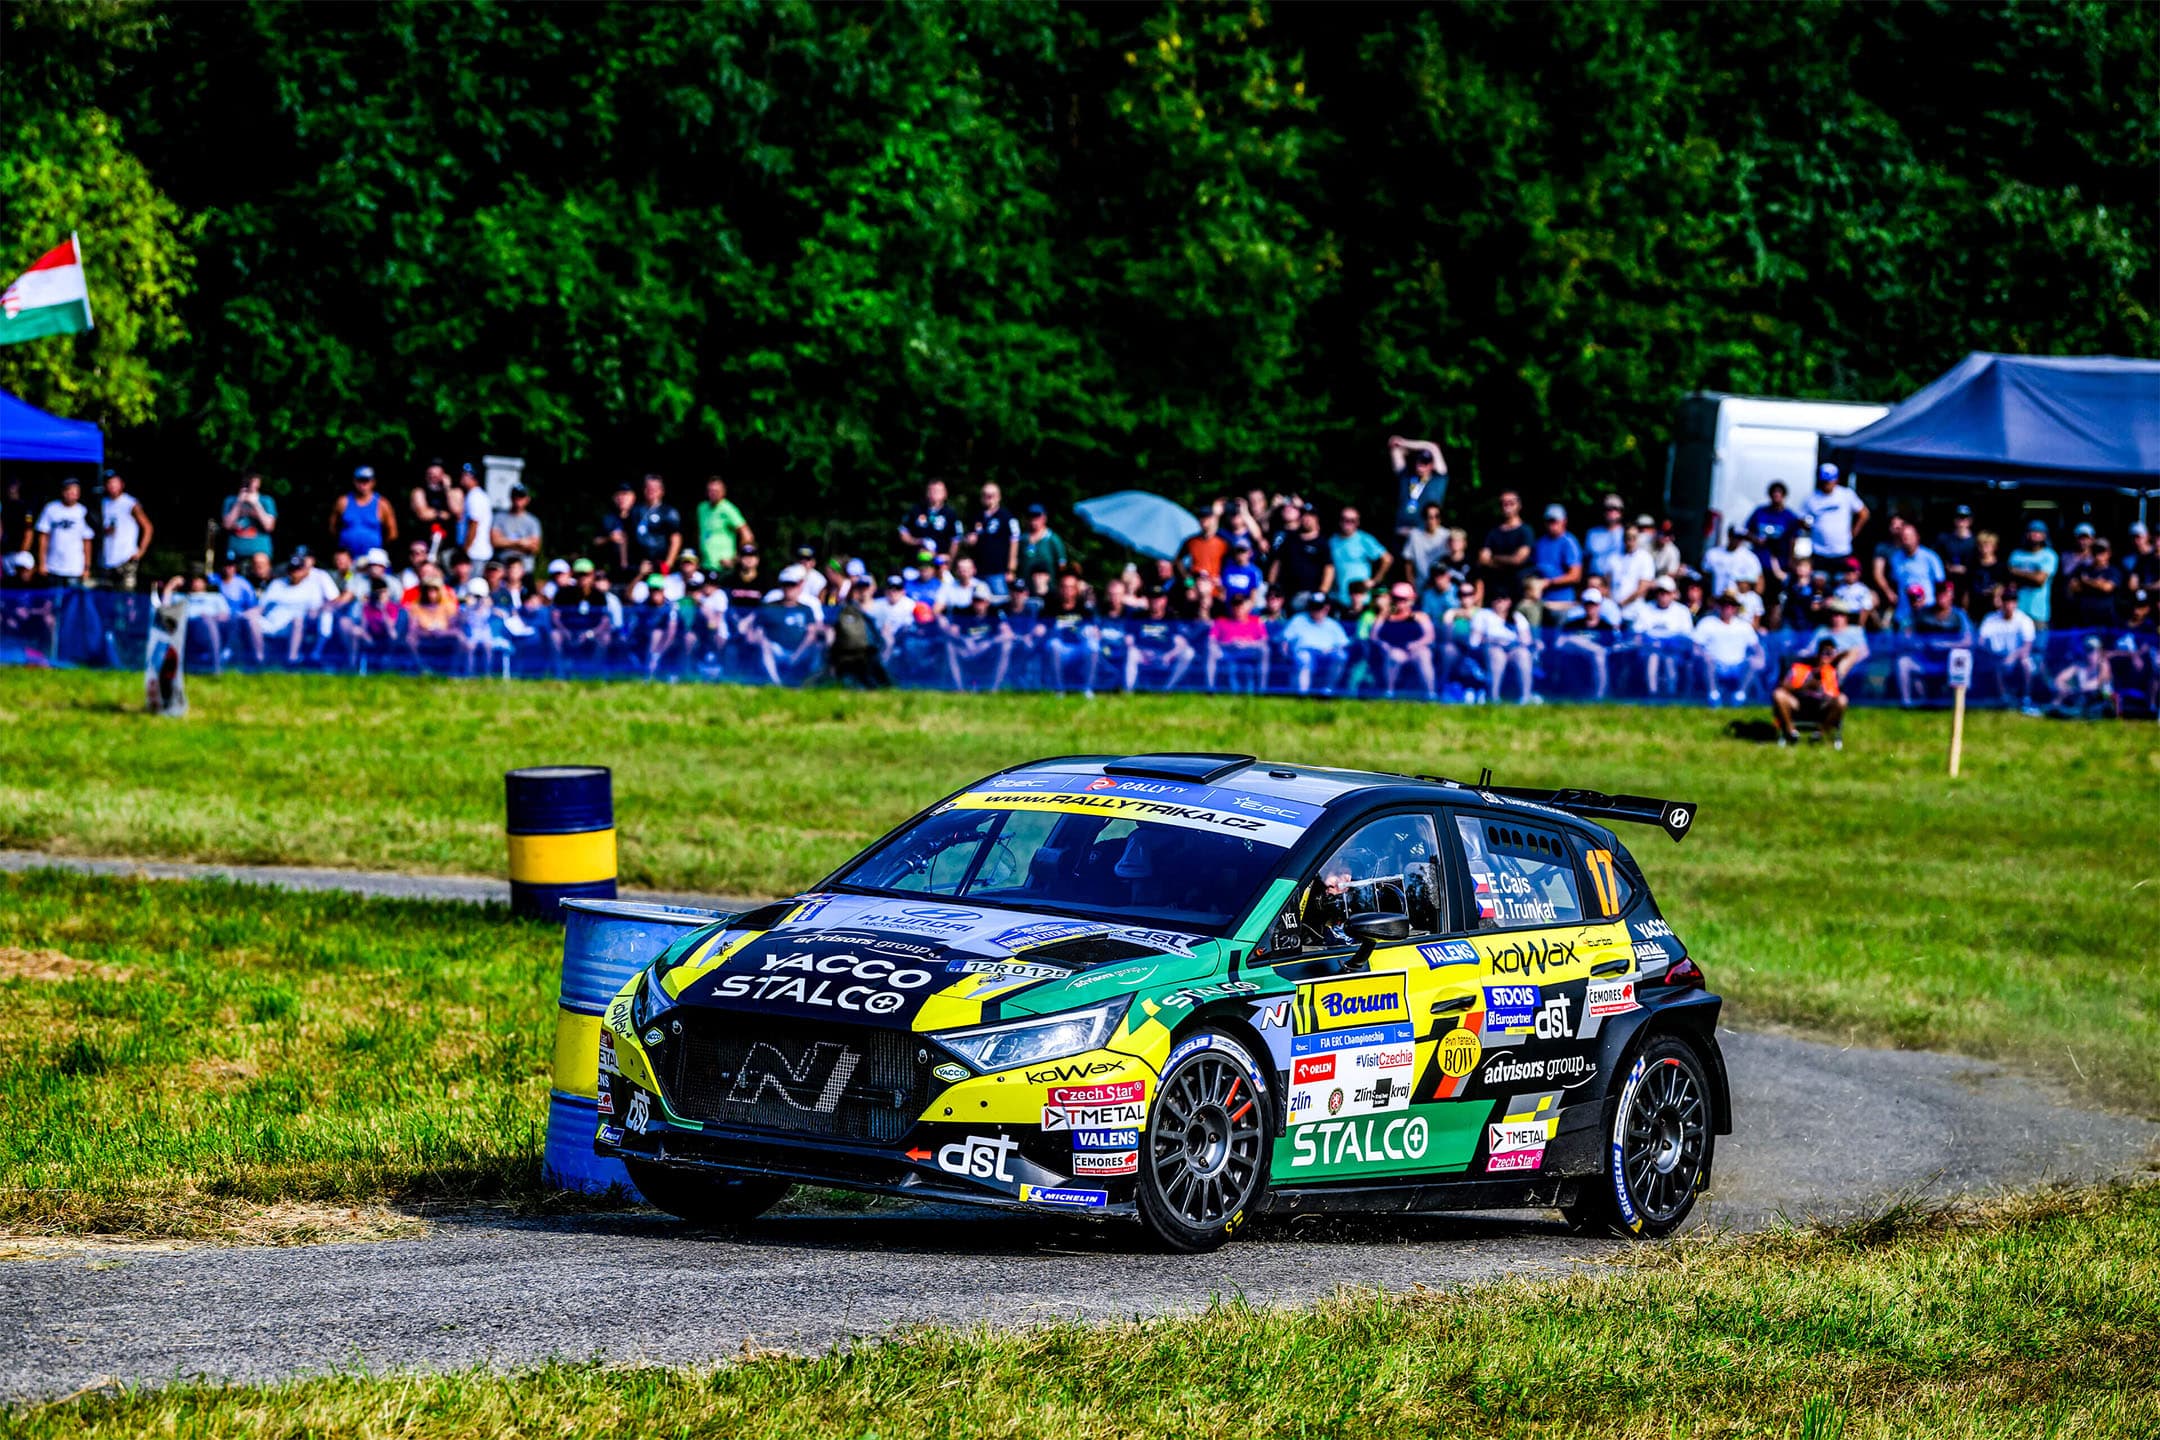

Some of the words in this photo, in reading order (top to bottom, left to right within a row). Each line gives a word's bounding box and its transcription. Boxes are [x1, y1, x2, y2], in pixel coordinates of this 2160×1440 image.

[1117, 781, 1168, 794] RALLY
[984, 794, 1267, 832] www.RALLYTRIKA.CZ
[1585, 849, 1620, 917] 17
[857, 914, 976, 933] HYUNDAI
[862, 921, 950, 936] MOTORSPORT
[874, 940, 932, 954] group
[1422, 944, 1475, 963] VALENS
[760, 953, 932, 989] YACCO
[1014, 965, 1069, 979] 0125
[711, 975, 905, 1014] STALCO
[1162, 981, 1261, 1009] STALCO
[1321, 991, 1399, 1017] Barum
[1589, 989, 1622, 1003] ČEMORES
[1495, 1013, 1532, 1027] Europartner
[1535, 993, 1573, 1040] dst
[1320, 1037, 1330, 1048] FIA
[1331, 1034, 1343, 1047] ERC
[1344, 1031, 1385, 1045] Championship
[1310, 1062, 1332, 1075] ORLEN
[1356, 1050, 1413, 1068] #VisitCzechia
[1443, 1047, 1478, 1074] BOW
[938, 1067, 967, 1077] YACCO
[1025, 1060, 1126, 1085] koWax
[1484, 1062, 1548, 1084] advisors
[1546, 1055, 1584, 1081] group
[1054, 1086, 1104, 1104] Czech
[1106, 1084, 1134, 1100] Star
[1391, 1082, 1410, 1099] kraj
[1290, 1091, 1311, 1112] zlín
[1070, 1106, 1144, 1125] TMETAL
[1079, 1131, 1137, 1146] VALENS
[1291, 1116, 1429, 1167] STALCO
[1506, 1129, 1546, 1145] TMETAL
[938, 1134, 1019, 1182] dst
[1075, 1155, 1123, 1167] ČEMORES
[1488, 1154, 1516, 1170] Czech
[1517, 1154, 1536, 1168] Star
[1045, 1192, 1098, 1203] MICHELIN
